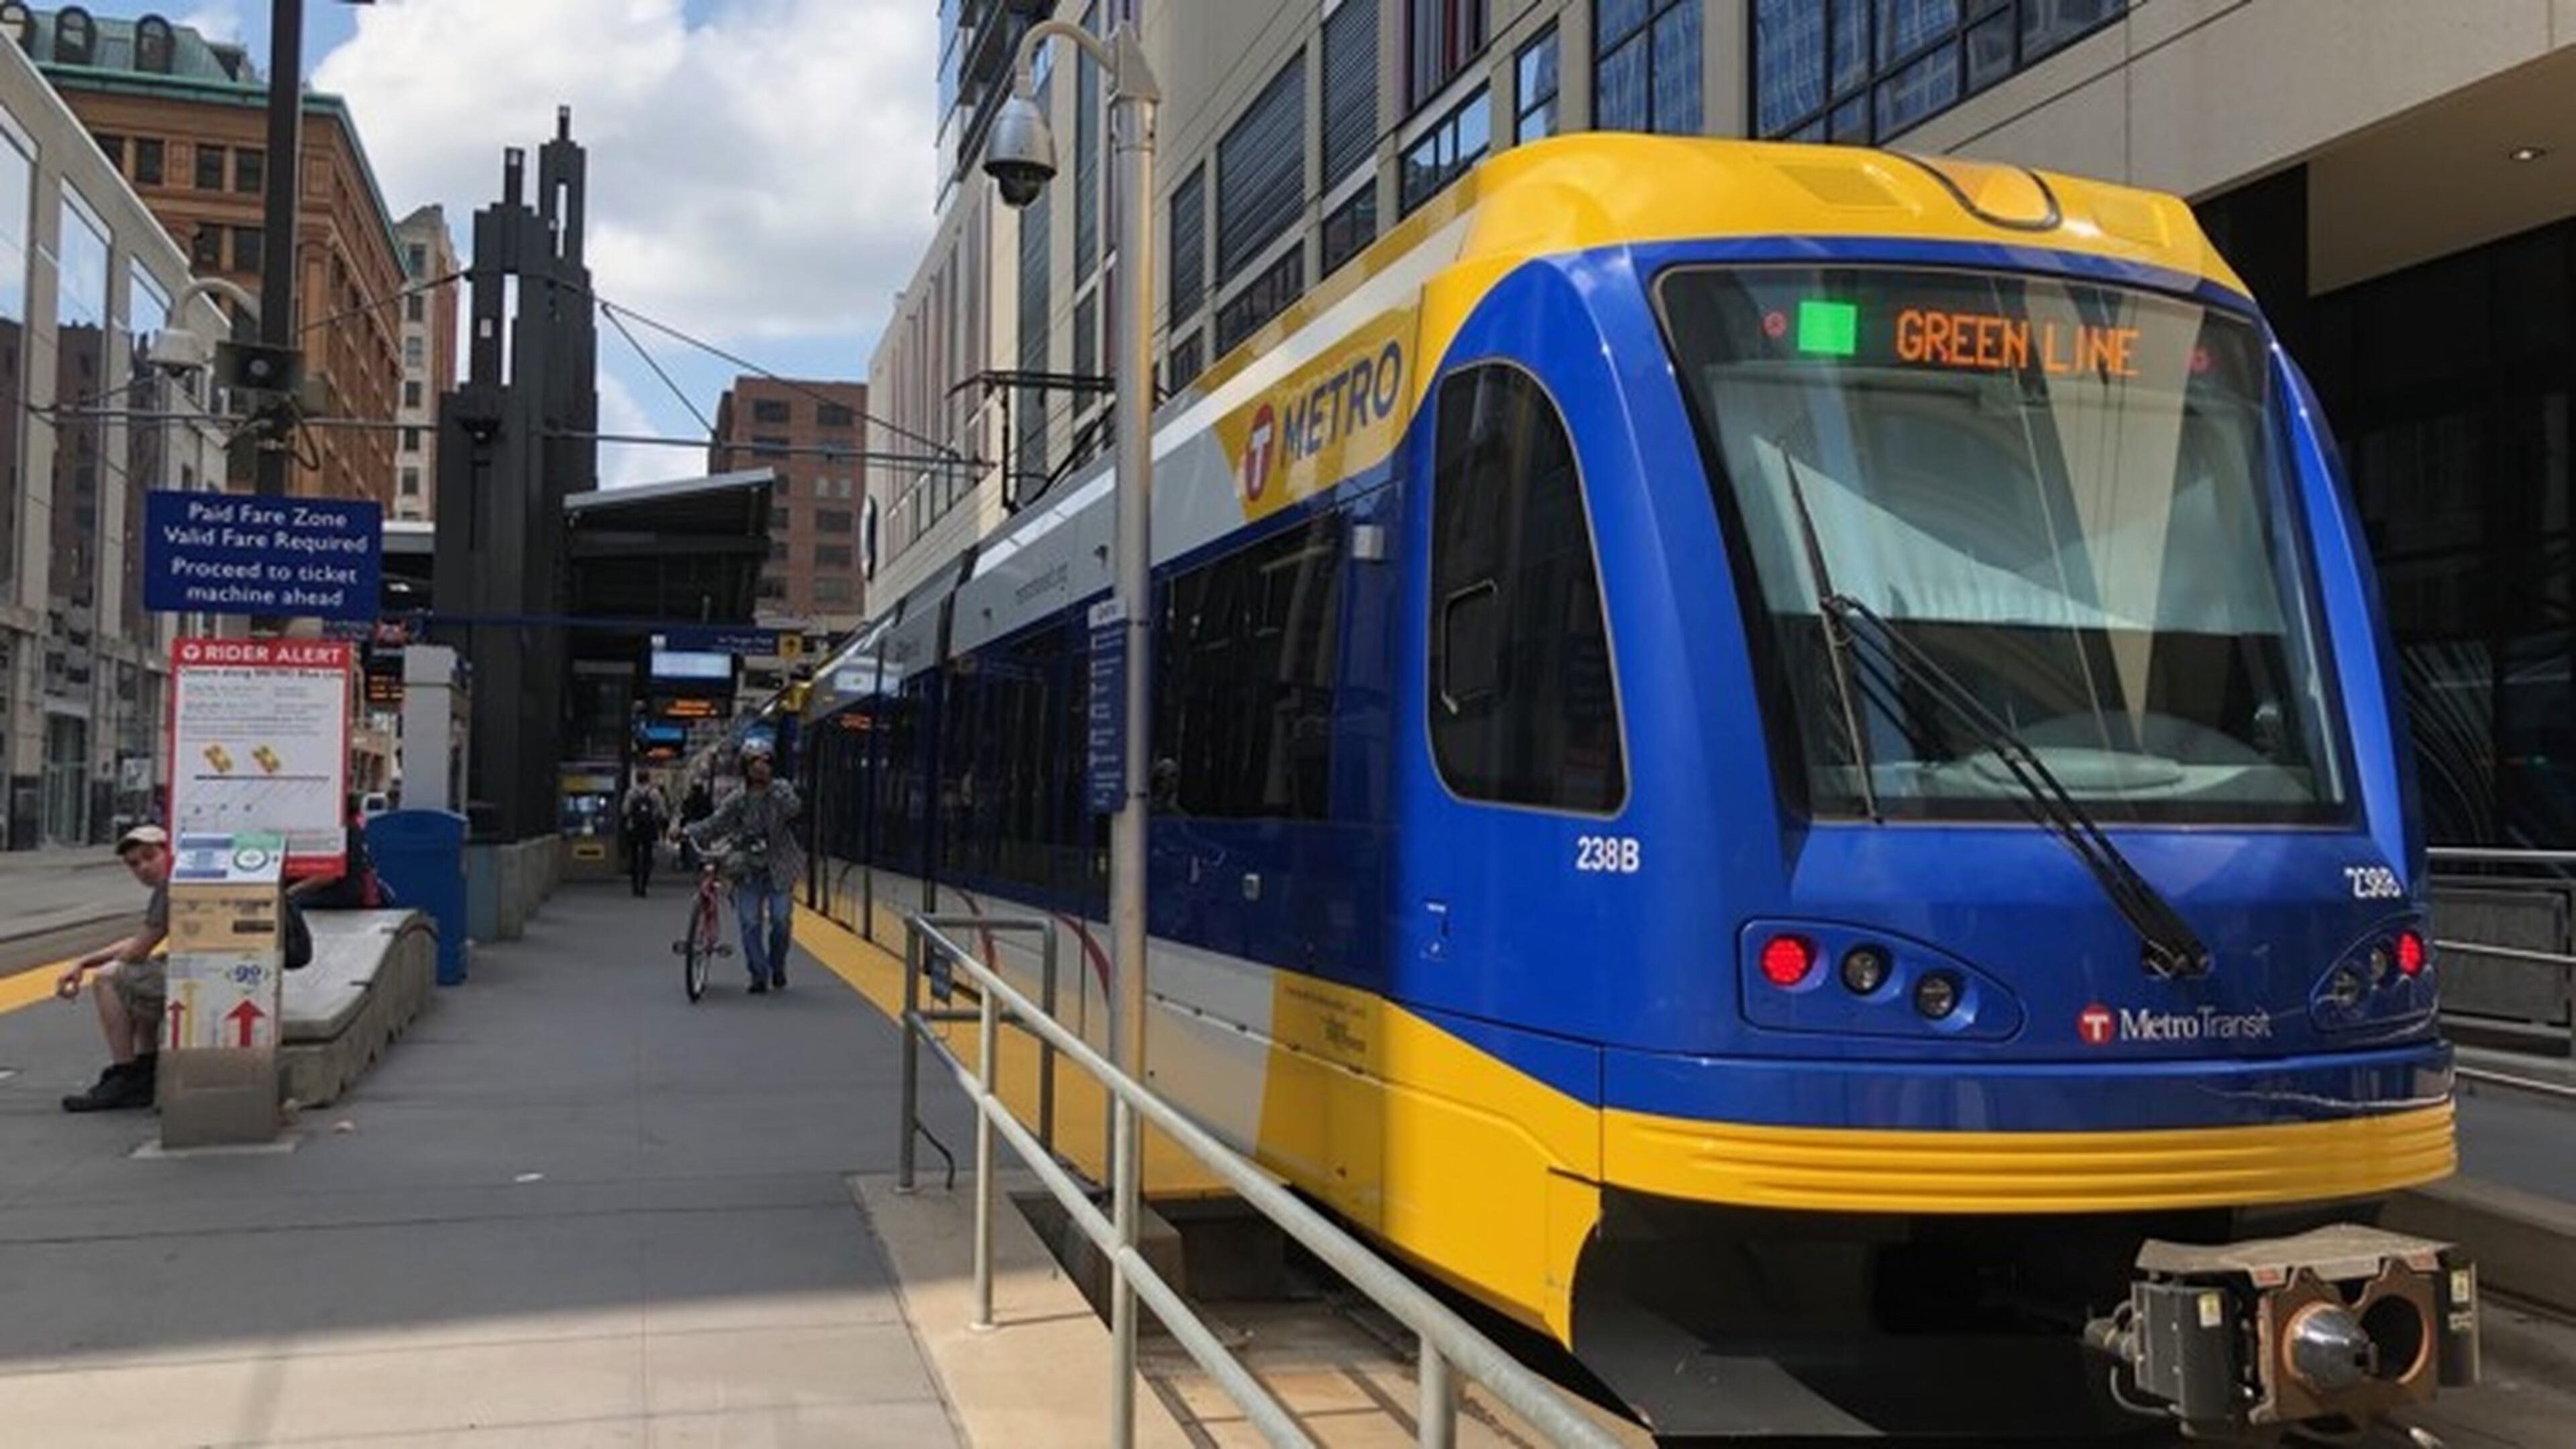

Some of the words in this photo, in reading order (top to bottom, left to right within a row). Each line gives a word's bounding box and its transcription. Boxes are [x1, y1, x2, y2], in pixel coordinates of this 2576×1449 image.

[1896, 309, 2028, 369] GREEN
[2043, 320, 2140, 377] LINE
[1279, 339, 1402, 470] METRO
[188, 502, 233, 523] Paid
[239, 504, 286, 525] Fare
[292, 508, 348, 528] Zone
[164, 525, 215, 545] Valid
[221, 529, 268, 547] Fare
[274, 531, 368, 555] Required
[170, 556, 262, 579] Proceed
[269, 564, 292, 581] to
[298, 564, 358, 584] ticket
[186, 584, 275, 604] machine
[282, 588, 344, 606] ahead
[205, 644, 269, 663] RIDER
[276, 647, 342, 664] ALERT
[1576, 836, 1640, 872] 238B
